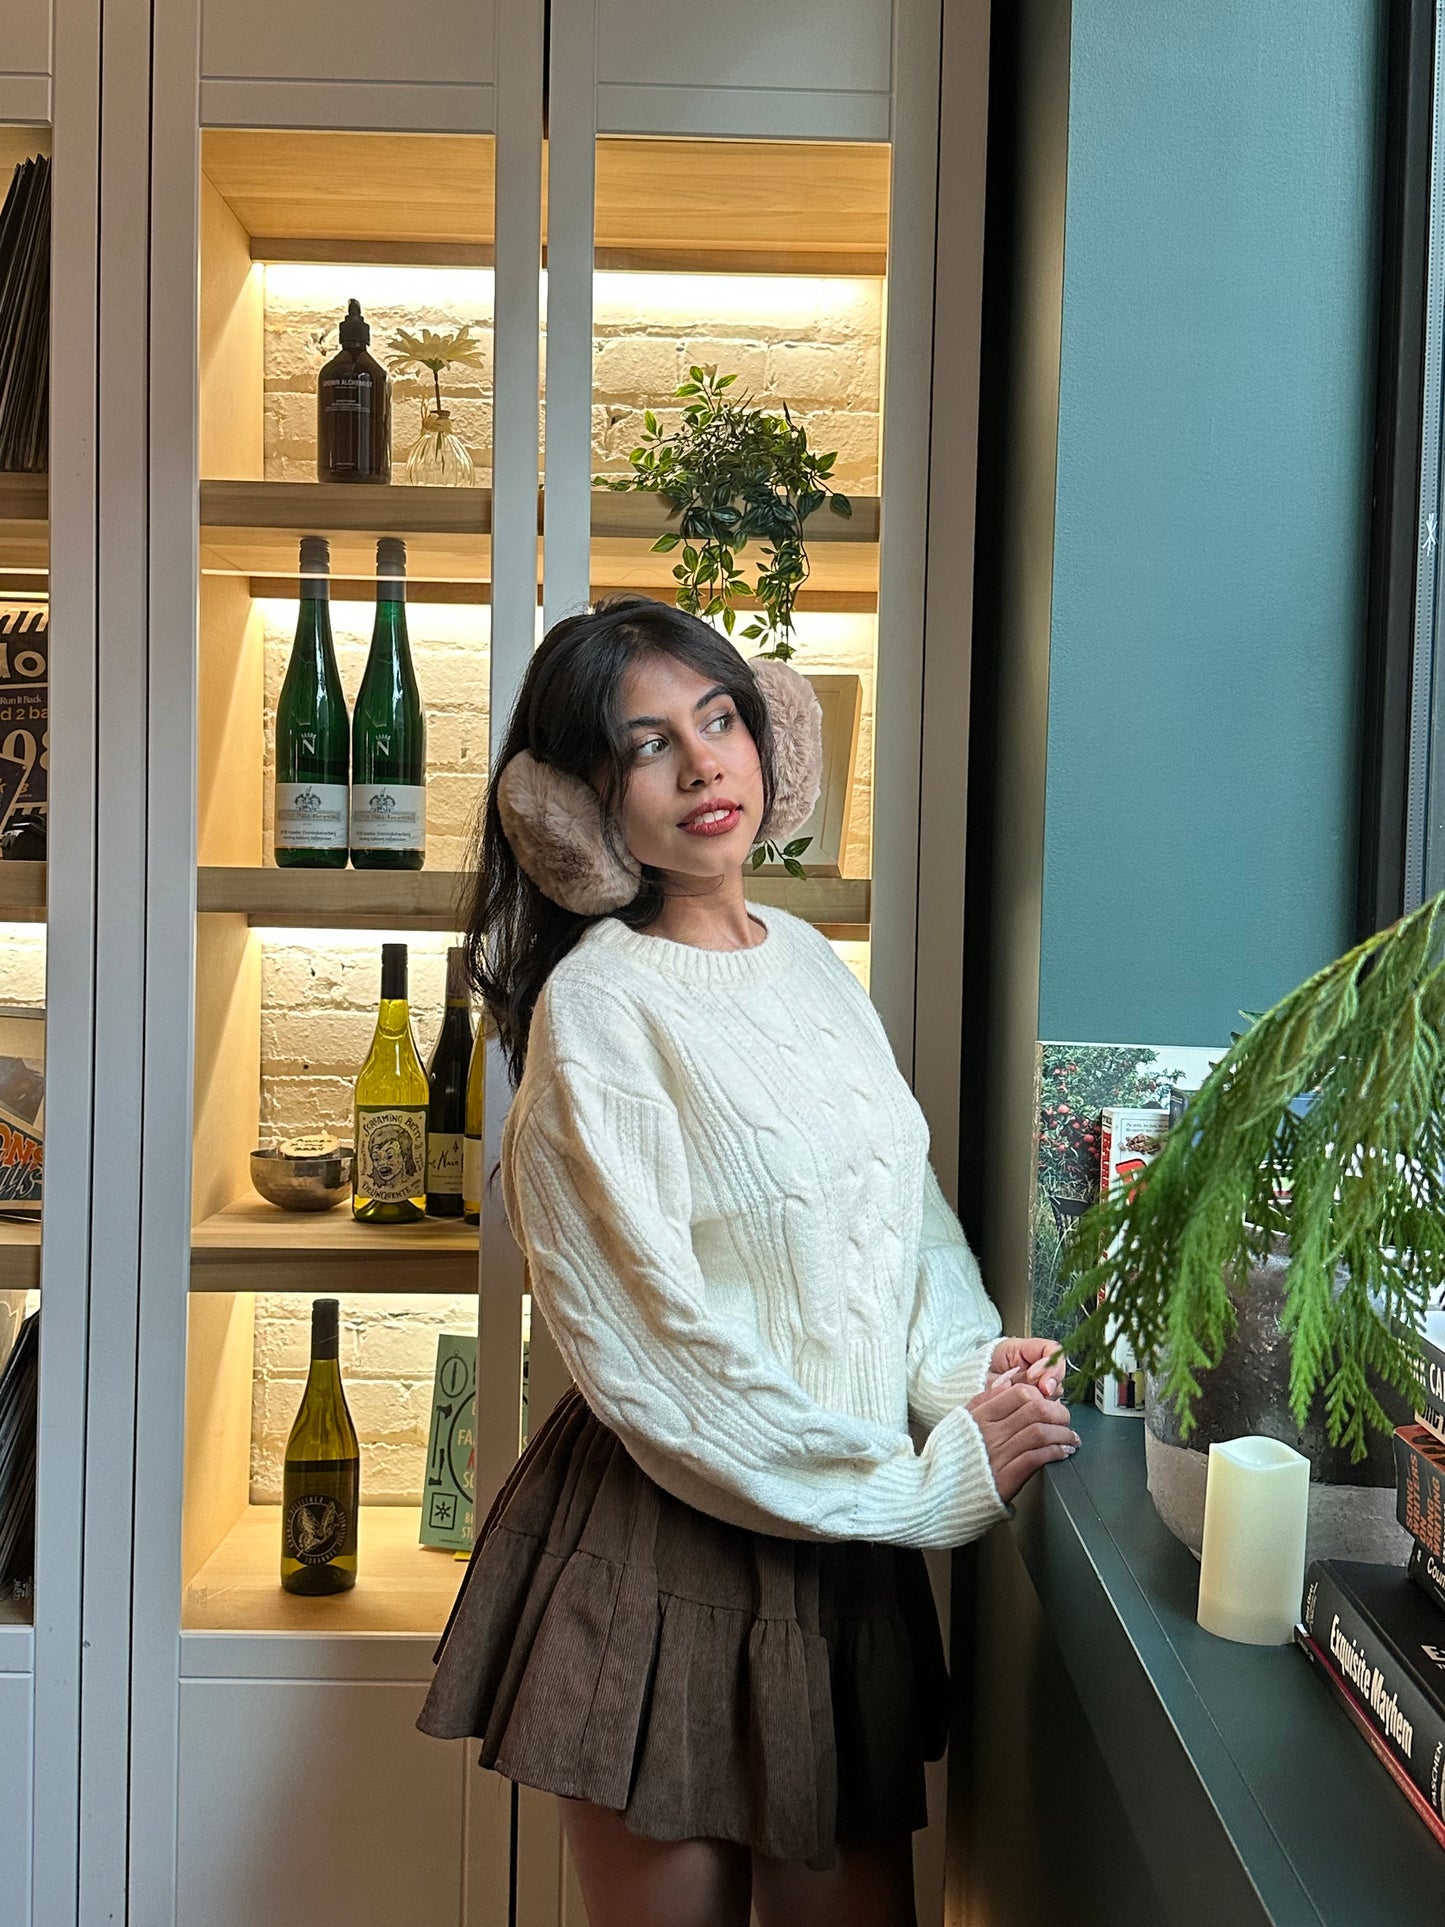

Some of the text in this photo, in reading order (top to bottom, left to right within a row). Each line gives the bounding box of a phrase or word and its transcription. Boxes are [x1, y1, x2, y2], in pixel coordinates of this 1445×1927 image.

[302, 739, 315, 755] N
[376, 740, 390, 756] N
[1405, 1477, 1414, 1530] SONG
[1410, 1453, 1421, 1537] WRITERS
[1432, 1475, 1442, 1557] WRITING
[1418, 1515, 1428, 1545] ON
[1425, 1497, 1435, 1551] SONG
[1330, 1614, 1414, 1760] Exquisite Mayhem
